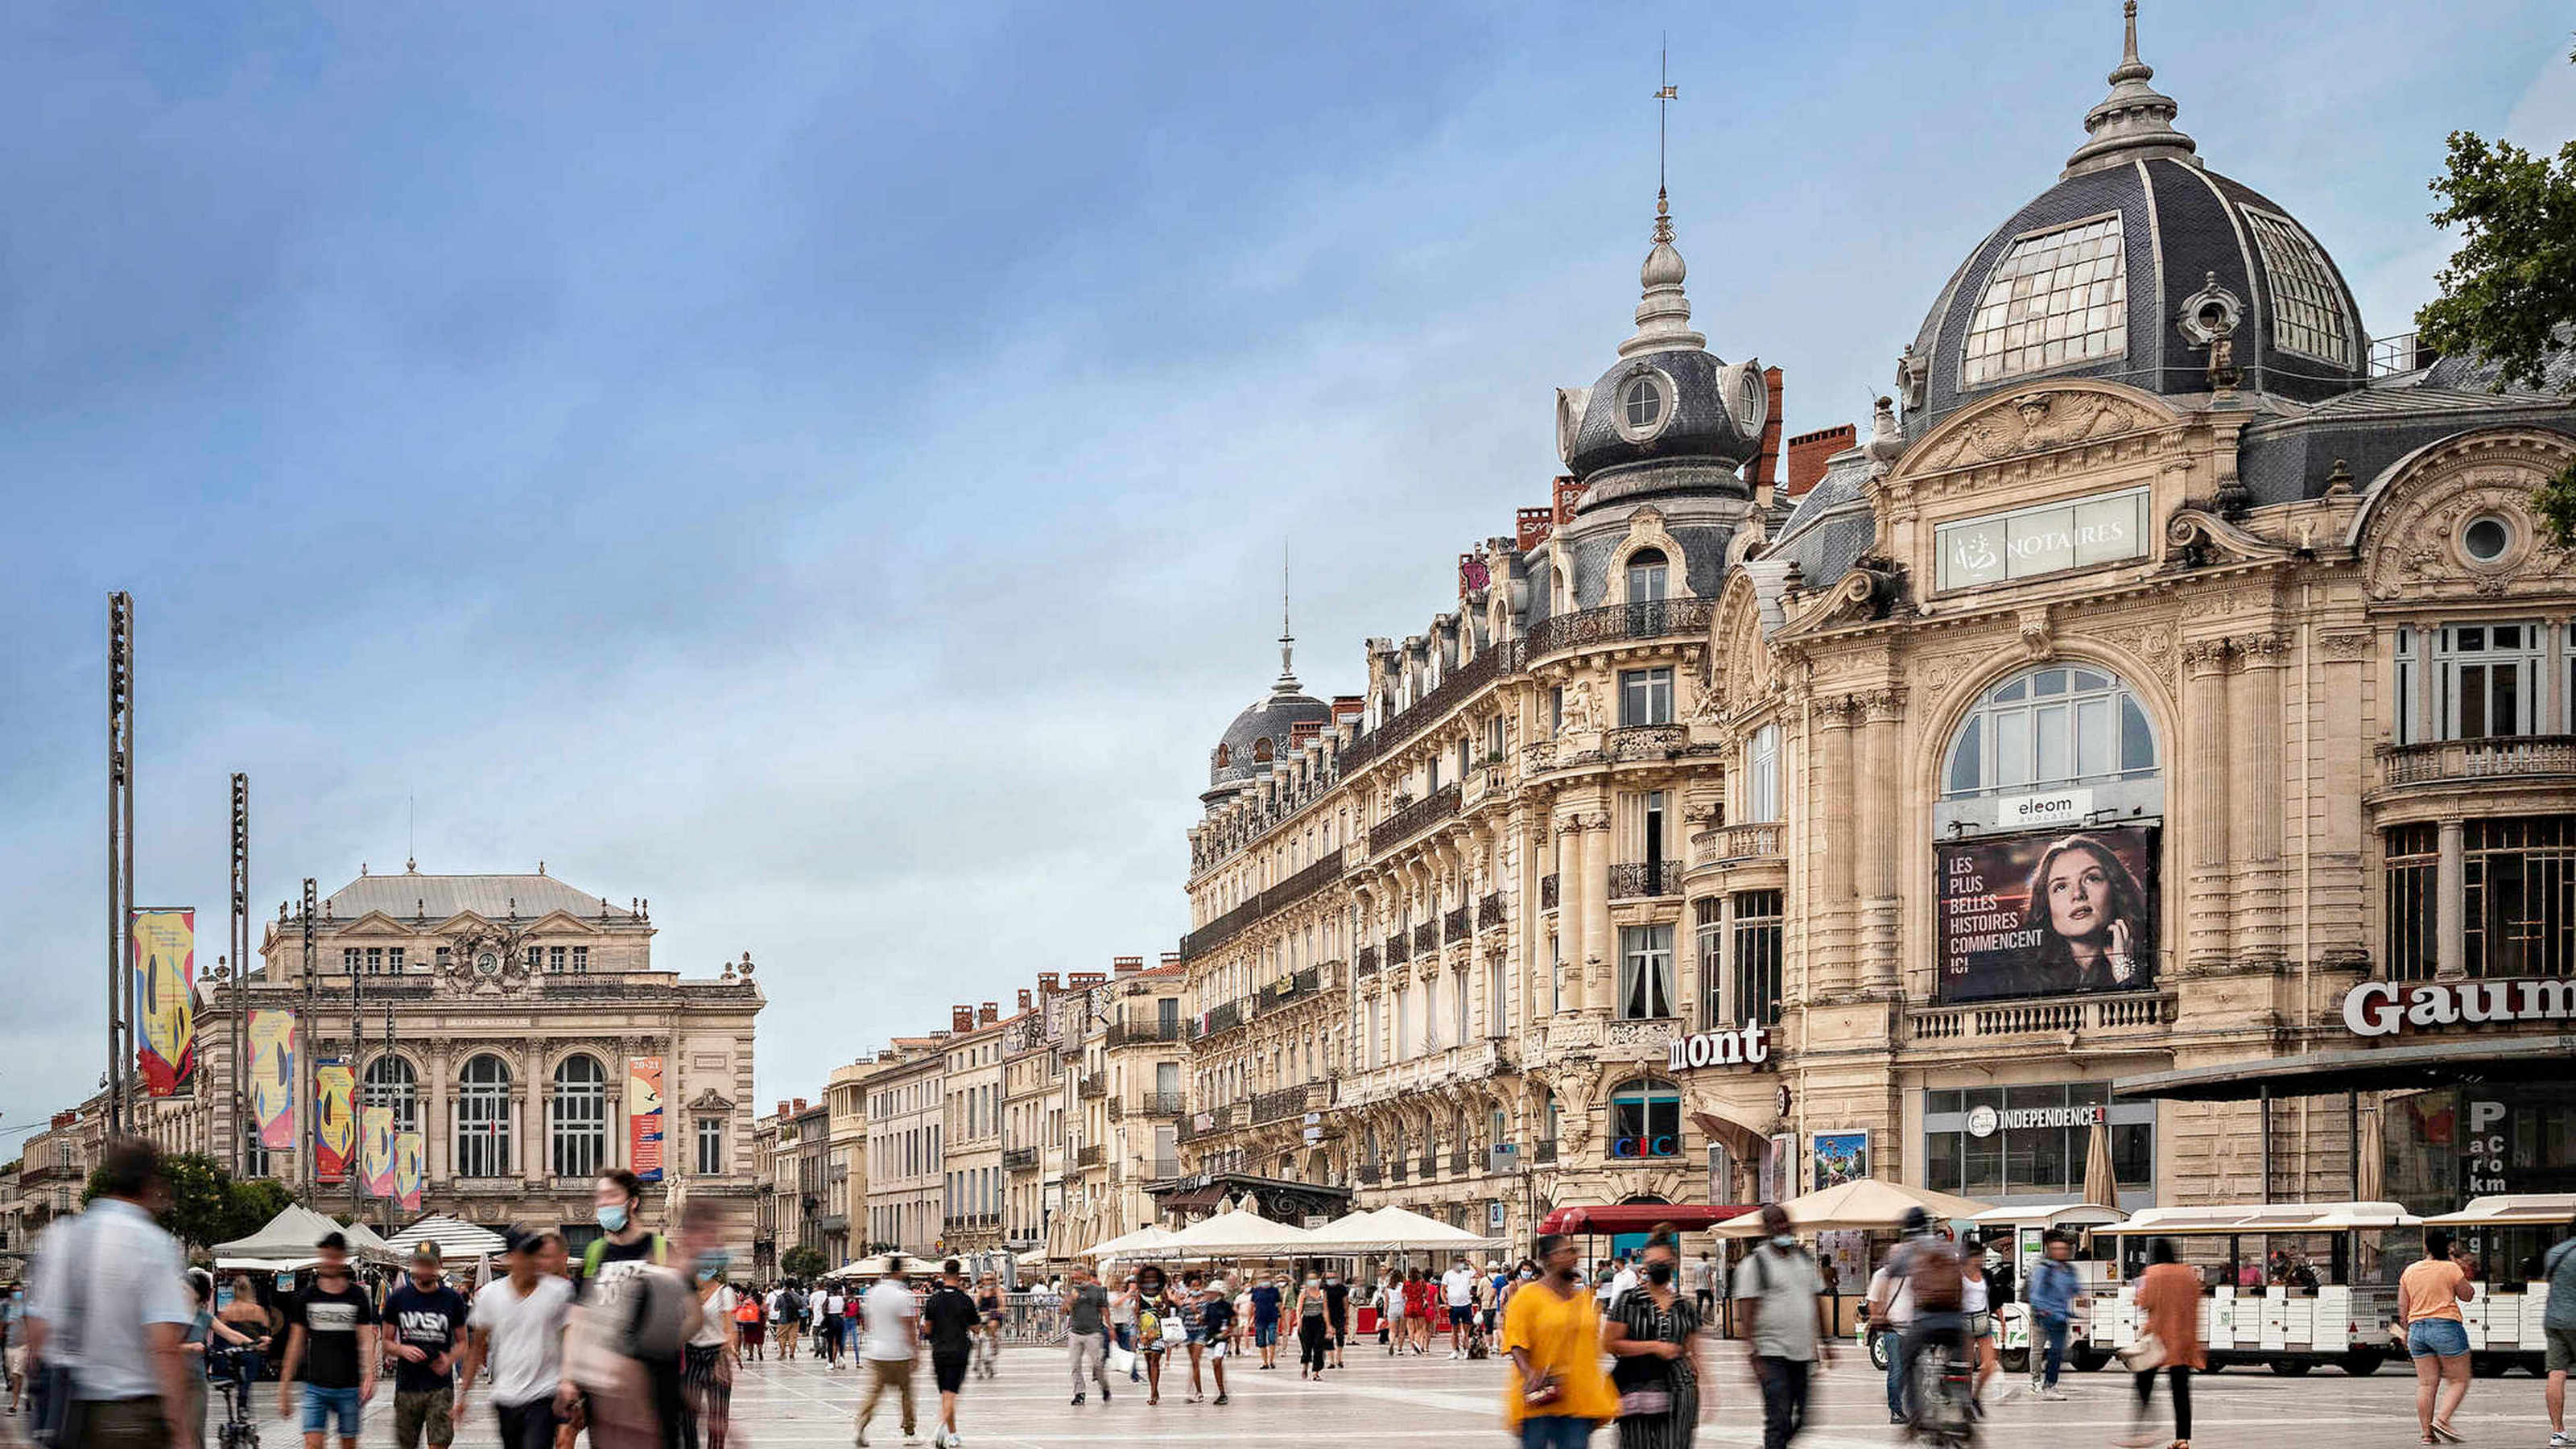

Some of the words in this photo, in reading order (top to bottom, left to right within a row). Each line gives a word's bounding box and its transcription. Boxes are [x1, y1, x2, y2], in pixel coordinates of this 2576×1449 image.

[2007, 522, 2124, 559] NOTAIRES
[2019, 798, 2072, 815] eleom
[1950, 857, 1973, 874] LES
[1950, 875, 1984, 894] PLUS
[1950, 894, 1997, 914] BELLES
[1950, 912, 2019, 934] HISTOIRES
[1951, 929, 2043, 954] COMMENCENT
[1951, 957, 1969, 974] ICI
[2343, 980, 2575, 1036] Gaum
[1668, 1018, 1768, 1072] mont
[2000, 1107, 2096, 1129] INDEPENDENCE
[1614, 1135, 1672, 1158] CIC
[398, 1311, 448, 1333] NASA
